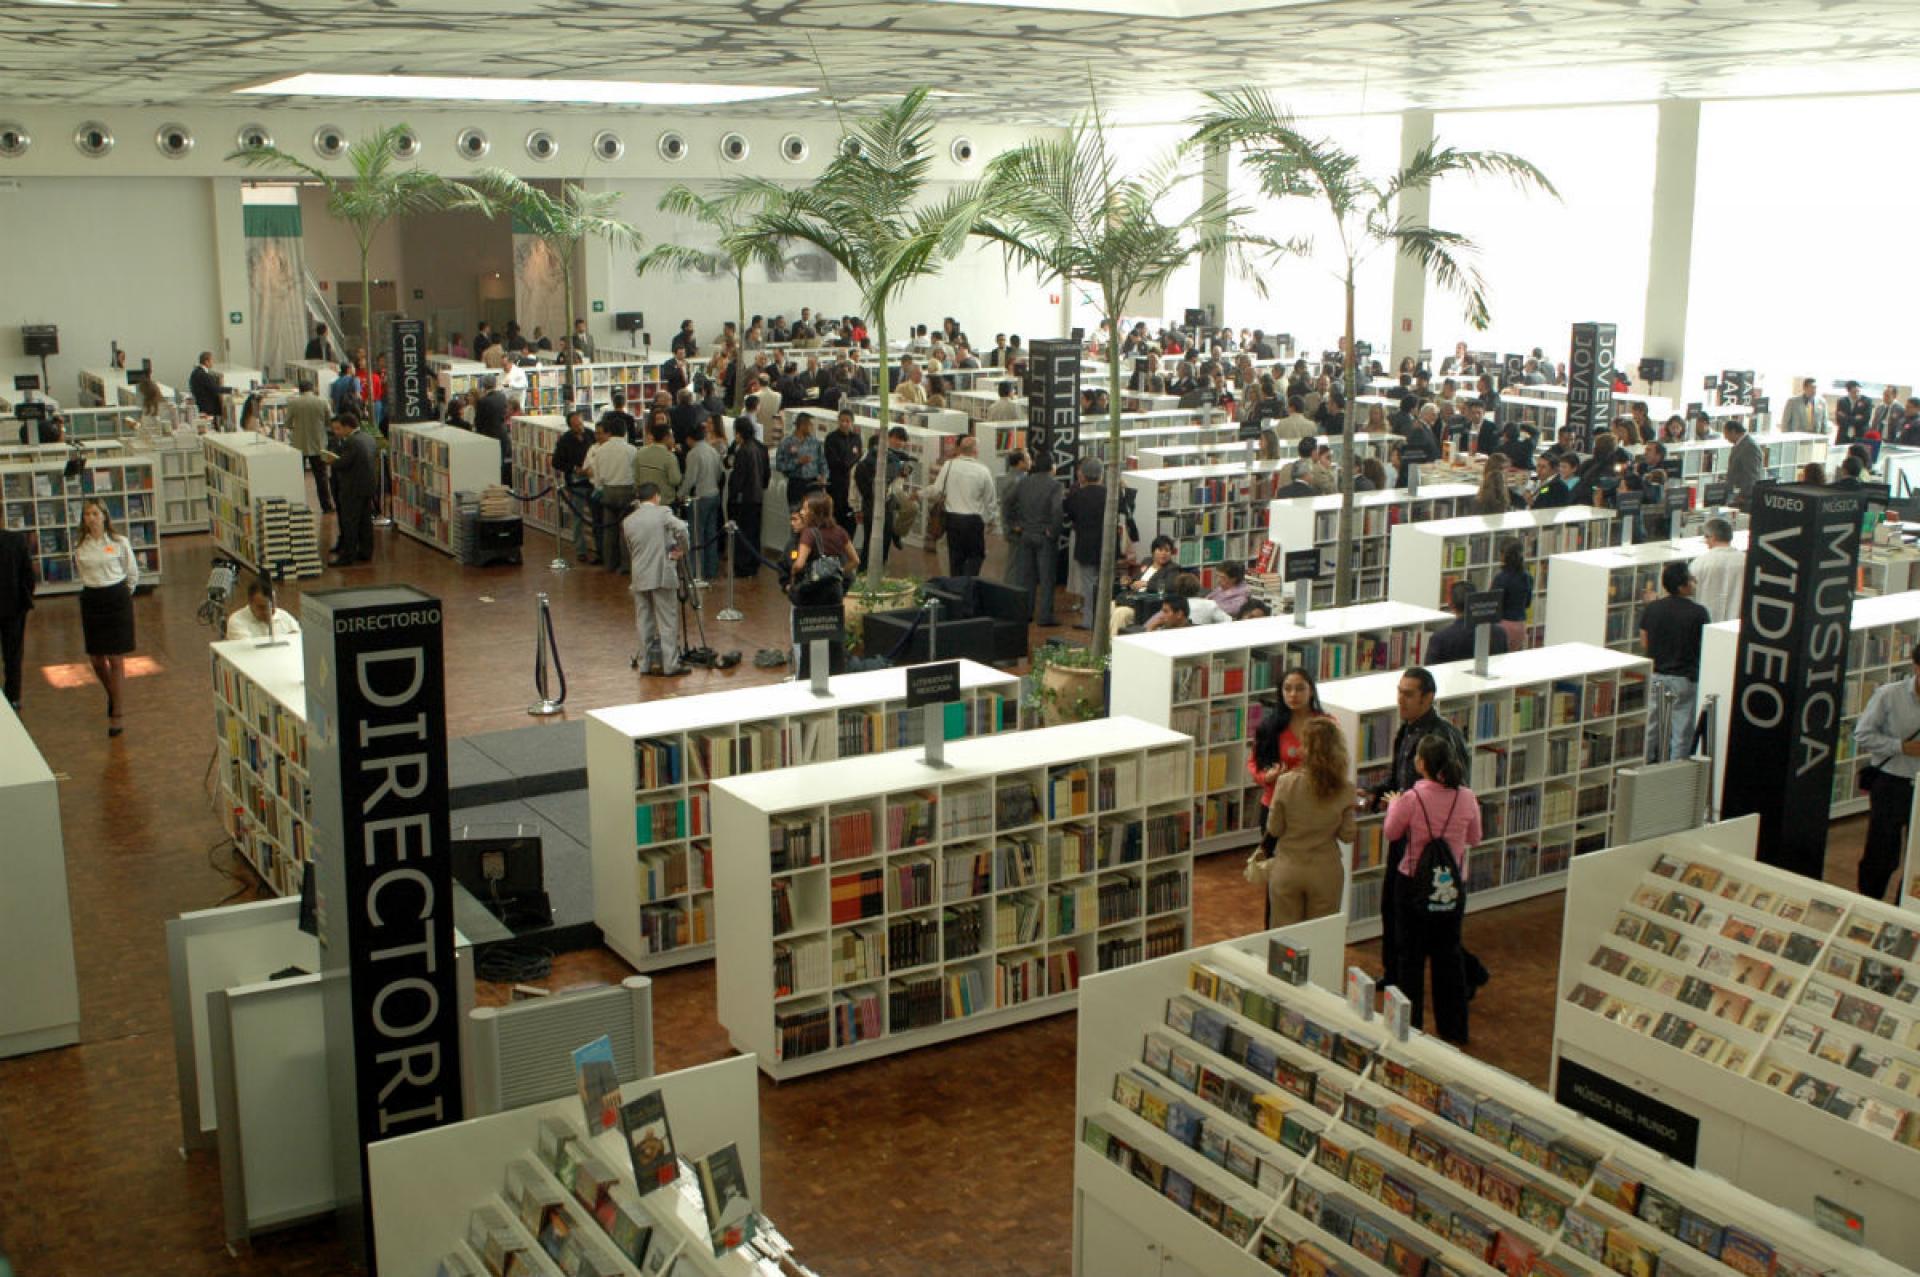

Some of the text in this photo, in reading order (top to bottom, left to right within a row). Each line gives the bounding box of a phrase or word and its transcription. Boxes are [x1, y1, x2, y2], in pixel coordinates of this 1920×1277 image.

[402, 333, 420, 417] CIENCIAS
[1763, 493, 1804, 513] VIDEO
[335, 608, 441, 633] DIRECTORIO
[1741, 525, 1803, 730] VIDEO
[1796, 521, 1856, 778] MÚSICA
